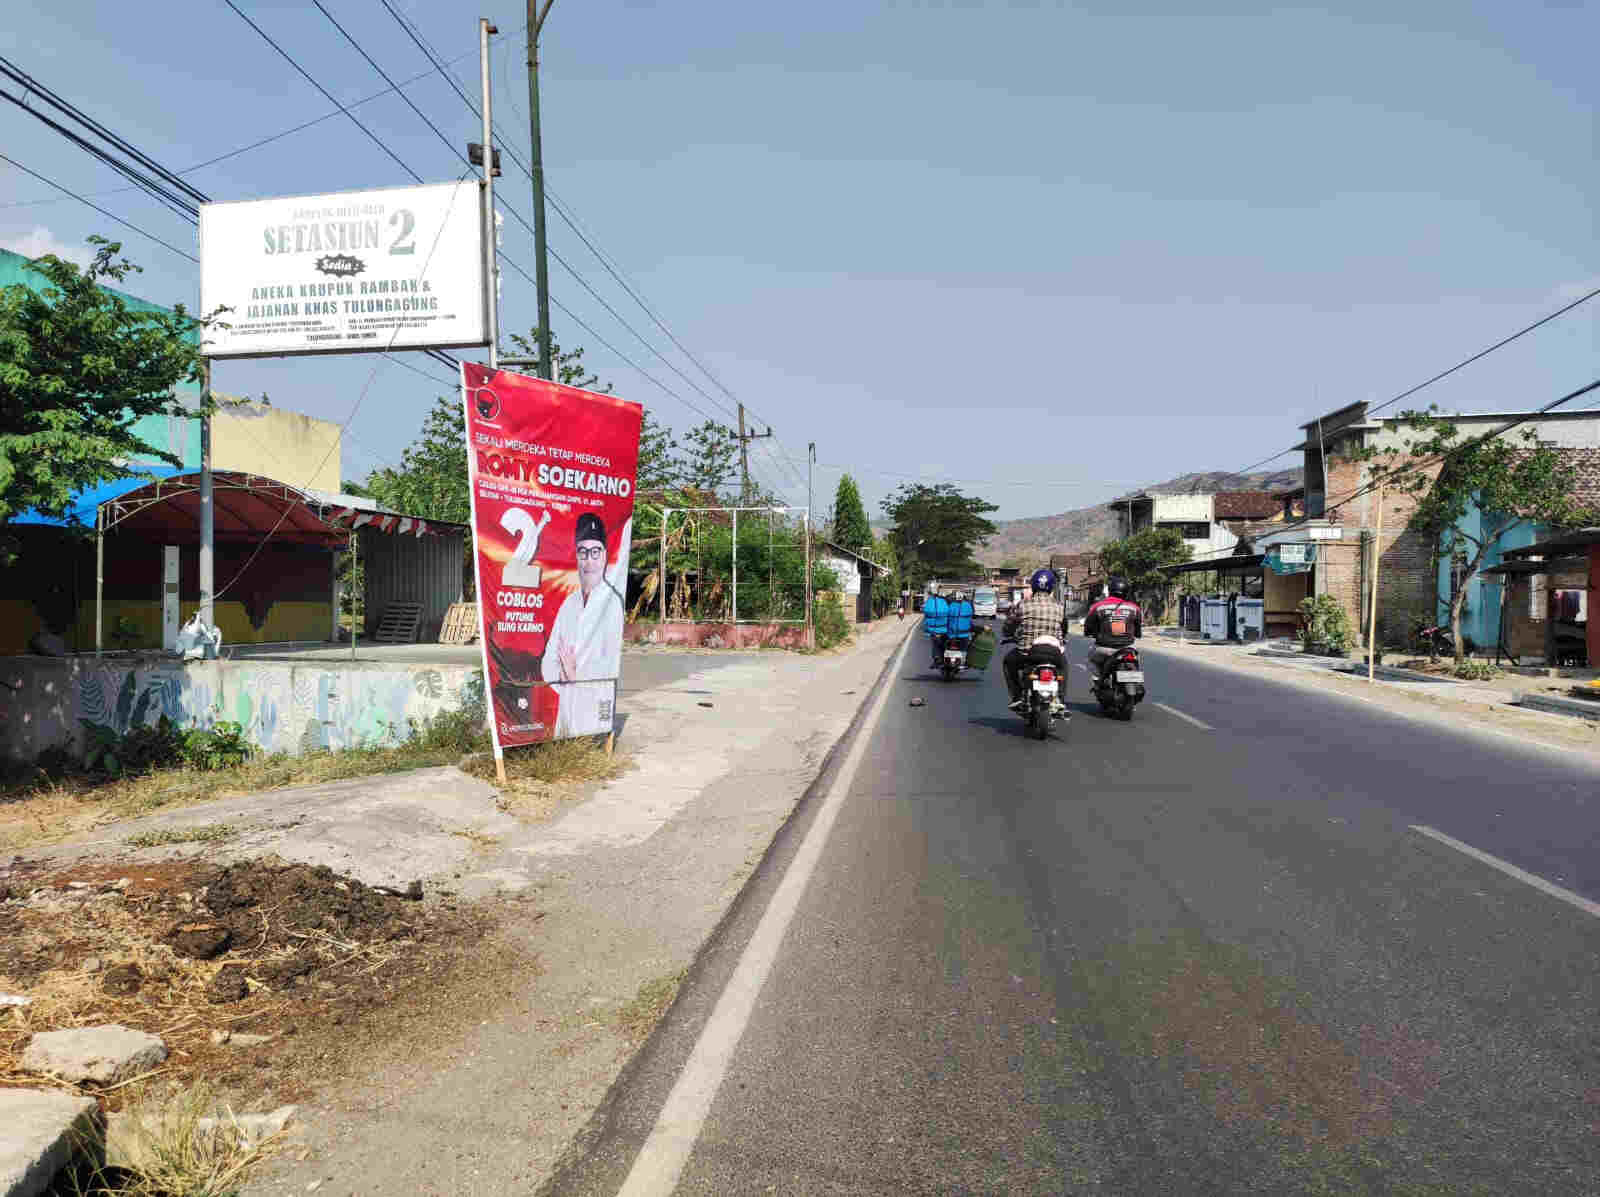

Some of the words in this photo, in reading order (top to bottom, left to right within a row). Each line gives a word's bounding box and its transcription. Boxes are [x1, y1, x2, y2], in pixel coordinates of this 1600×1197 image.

[264, 220, 379, 255] SETASIUN
[388, 208, 416, 255] 2
[251, 283, 294, 301] ANEKA
[299, 281, 355, 298] KRUPUK
[360, 279, 419, 296] RAMBAK
[422, 280, 432, 293] &
[247, 300, 299, 319] JAJANAN
[304, 299, 338, 317] KHAS
[343, 296, 439, 315] TULUNGAGUNG
[504, 438, 547, 457] MERDEKA
[549, 447, 574, 461] TETAP
[575, 452, 612, 468] MERDEKA
[537, 462, 632, 498] SOEKARNO
[500, 507, 543, 588] 2
[496, 591, 544, 609] COBLOS
[517, 622, 545, 633] KARNO
